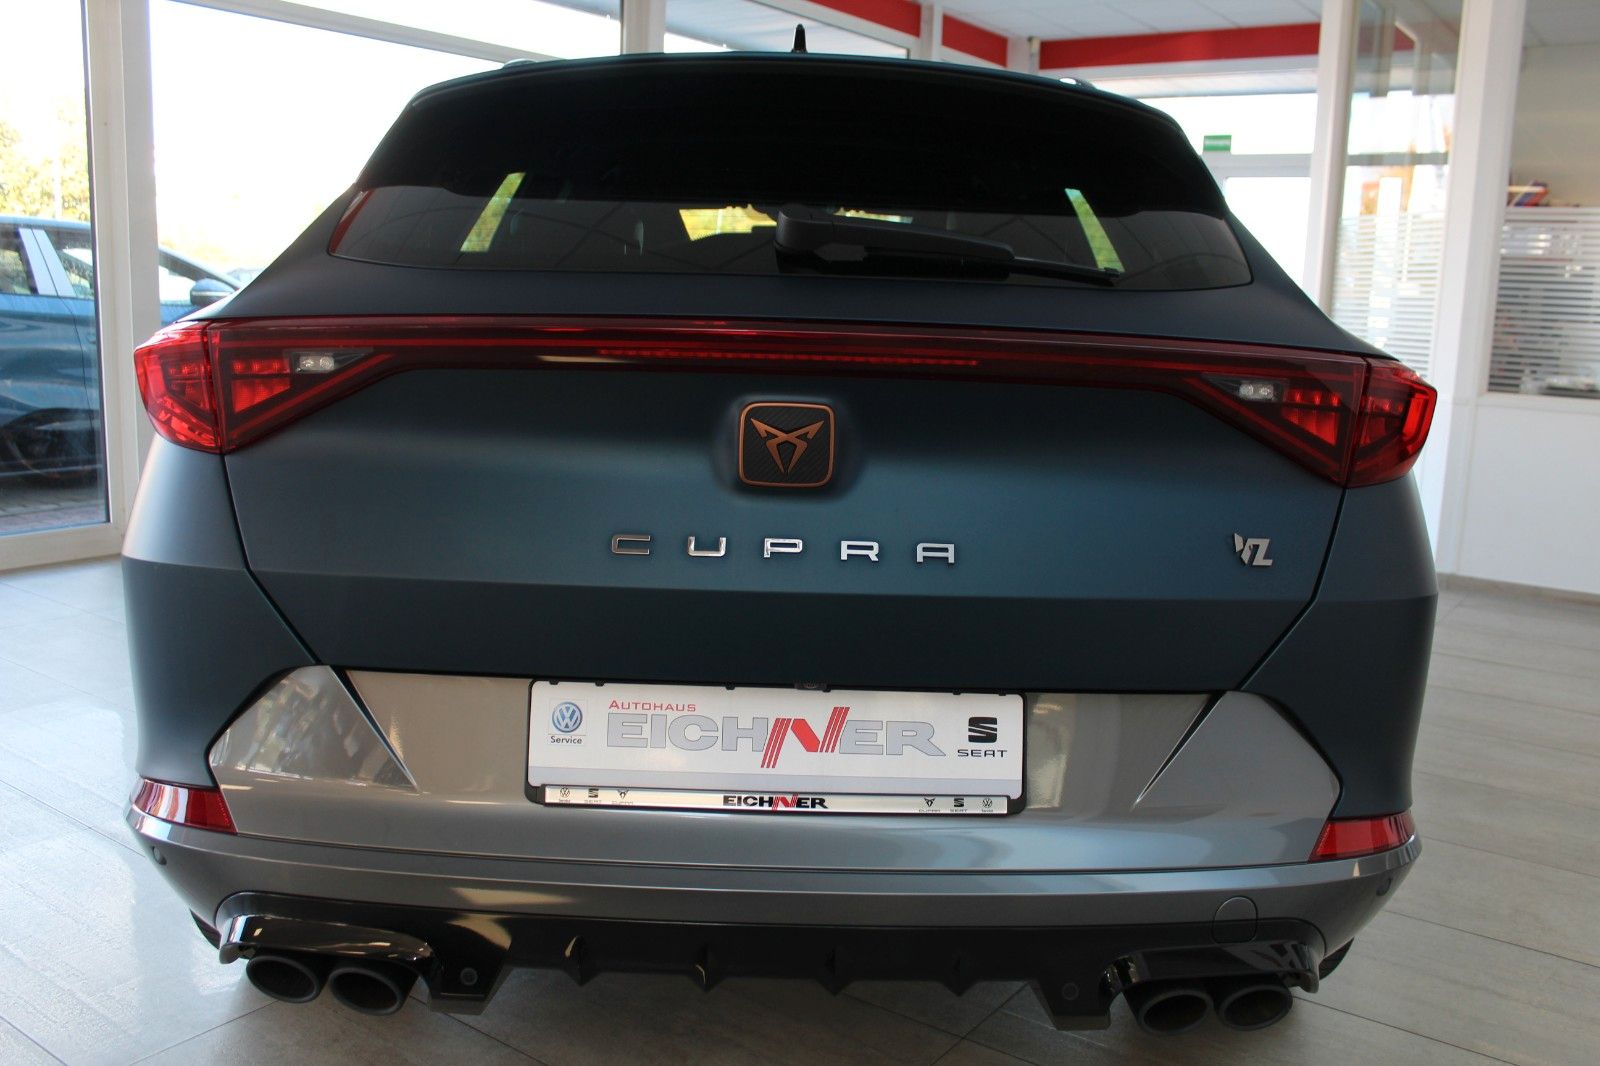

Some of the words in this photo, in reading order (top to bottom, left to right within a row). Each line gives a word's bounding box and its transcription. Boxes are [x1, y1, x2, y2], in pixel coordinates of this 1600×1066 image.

[610, 534, 955, 564] CUPRA
[609, 700, 696, 712] AUTOHAUS
[550, 735, 583, 744] Service
[607, 708, 946, 768] EICHNER
[957, 749, 1008, 758] SEAT
[723, 794, 828, 811] EICHNER
